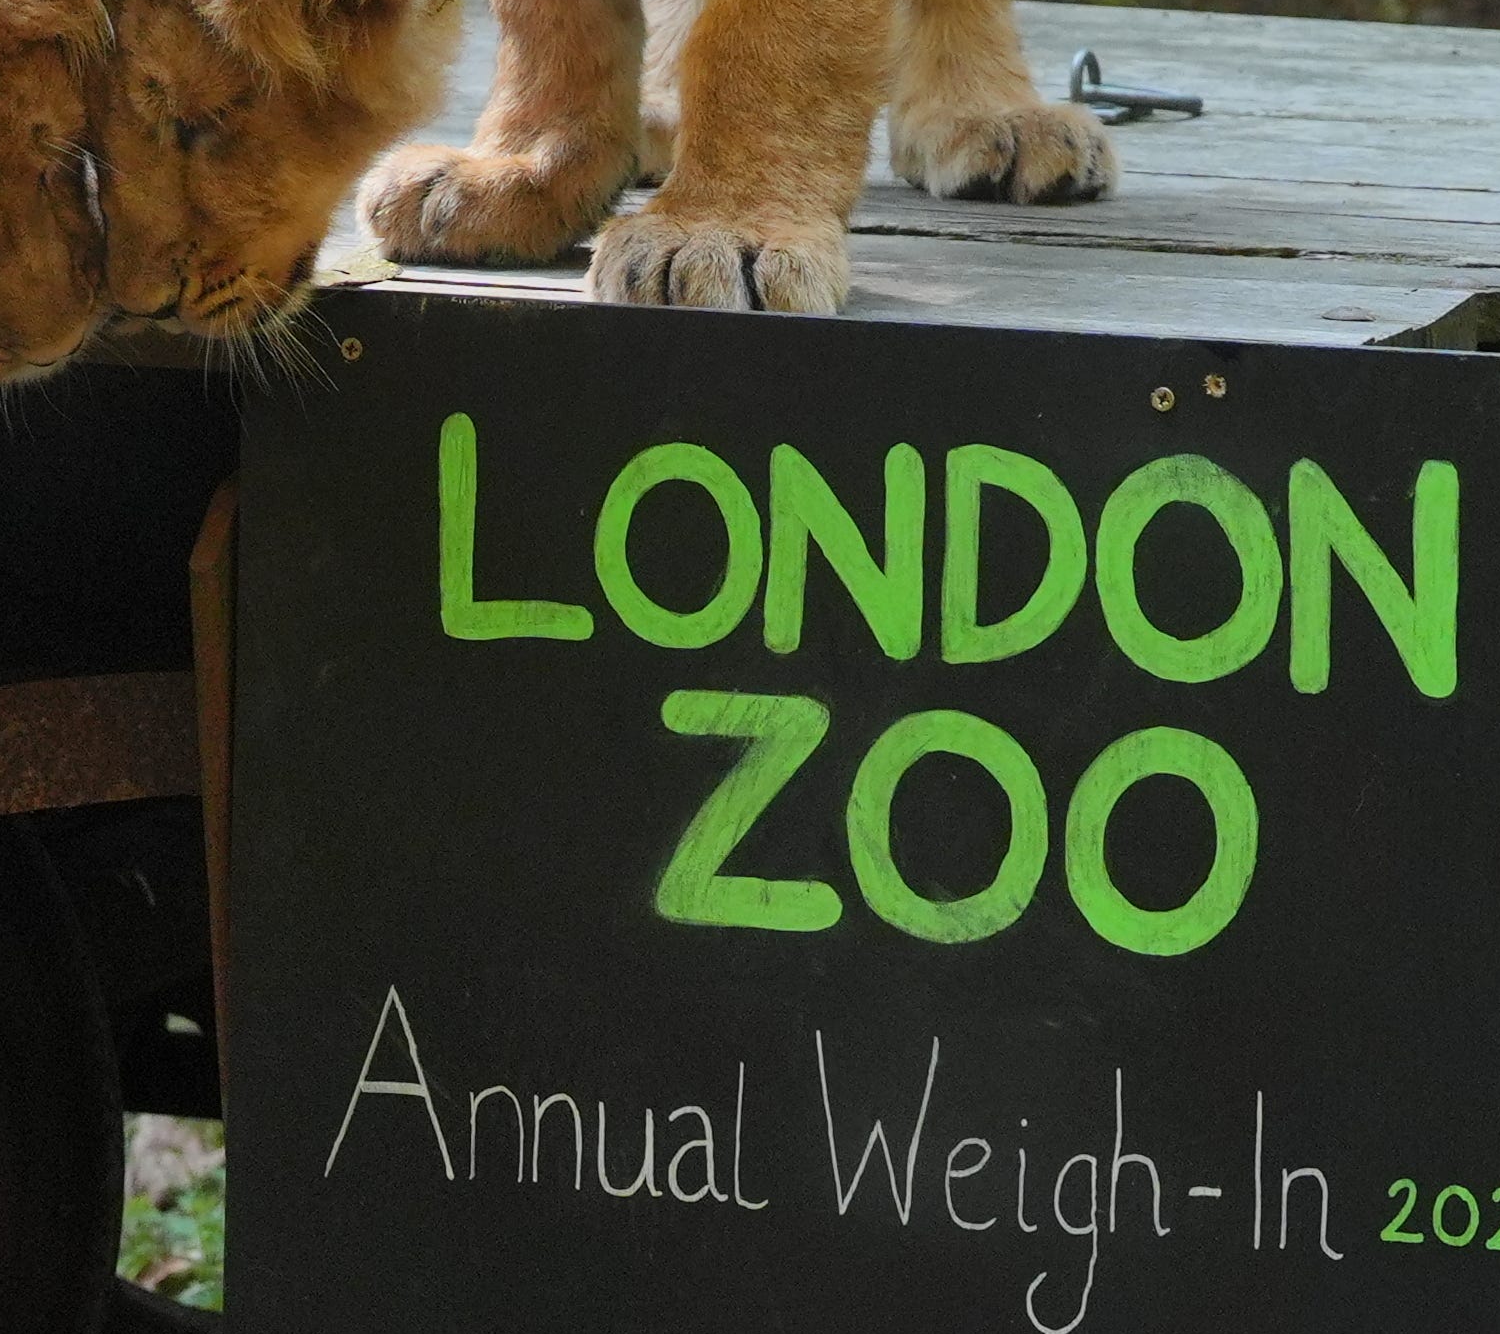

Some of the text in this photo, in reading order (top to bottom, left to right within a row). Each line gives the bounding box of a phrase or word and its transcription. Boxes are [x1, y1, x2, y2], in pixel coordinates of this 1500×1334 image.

[437, 411, 1461, 700] LONDON
[653, 688, 1260, 958] ZOO
[323, 983, 770, 1211] Annual
